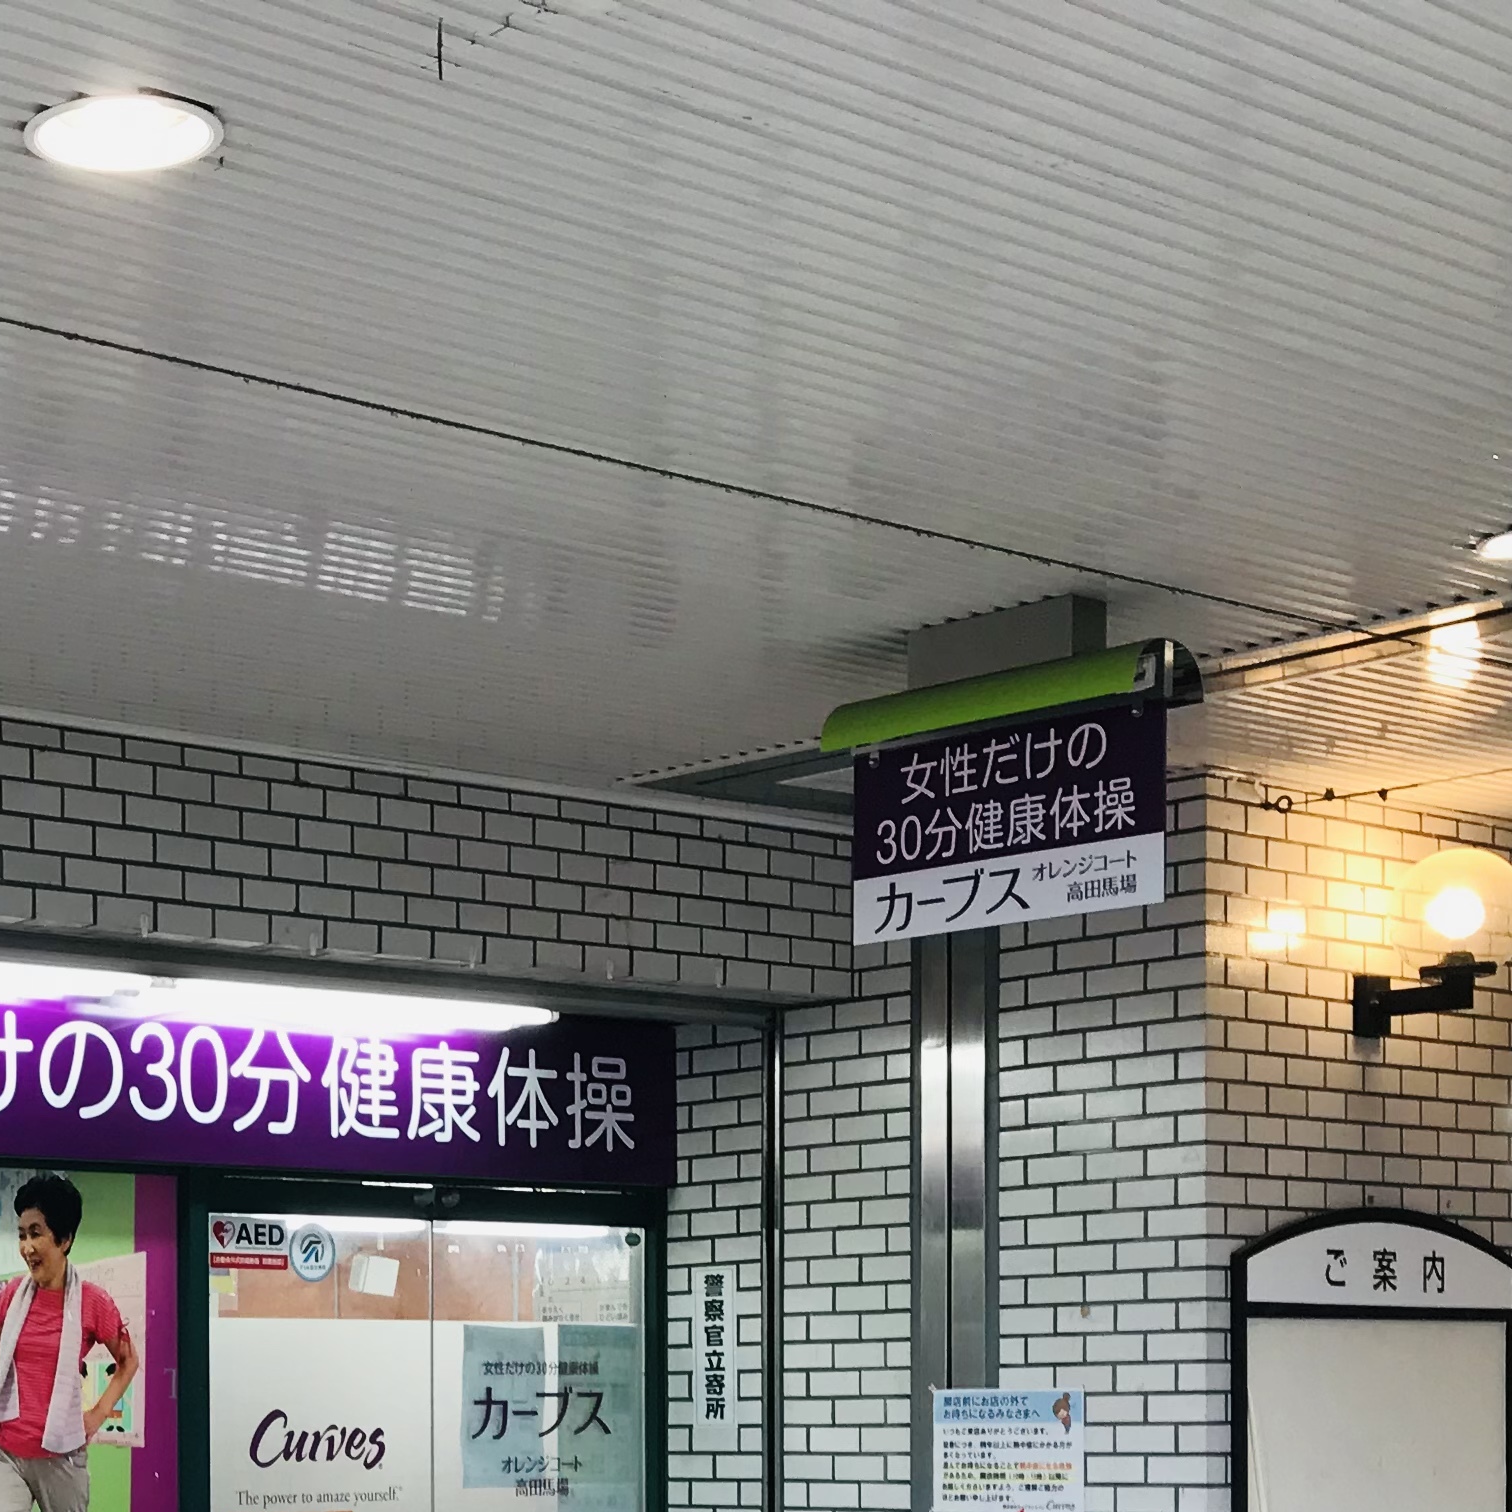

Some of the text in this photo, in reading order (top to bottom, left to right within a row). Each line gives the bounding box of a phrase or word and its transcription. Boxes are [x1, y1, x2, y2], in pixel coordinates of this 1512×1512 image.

[900, 722, 1108, 804] 女性だけの
[875, 776, 1137, 866] 30分健康体操
[1031, 849, 1138, 882] オレンジコート
[1066, 873, 1138, 903] 高田馬場
[874, 867, 1031, 935] カーブス
[236, 1223, 285, 1246] AED
[1325, 1247, 1445, 1293] ご案内
[704, 1273, 725, 1420] 警察官立寄所
[471, 1386, 612, 1440] カーブス
[249, 1409, 386, 1470] Curves
[501, 1455, 583, 1473] オレンジコート
[235, 1490, 259, 1506] The
[263, 1493, 297, 1509] power
[301, 1493, 313, 1504] to
[316, 1492, 351, 1503] amaze
